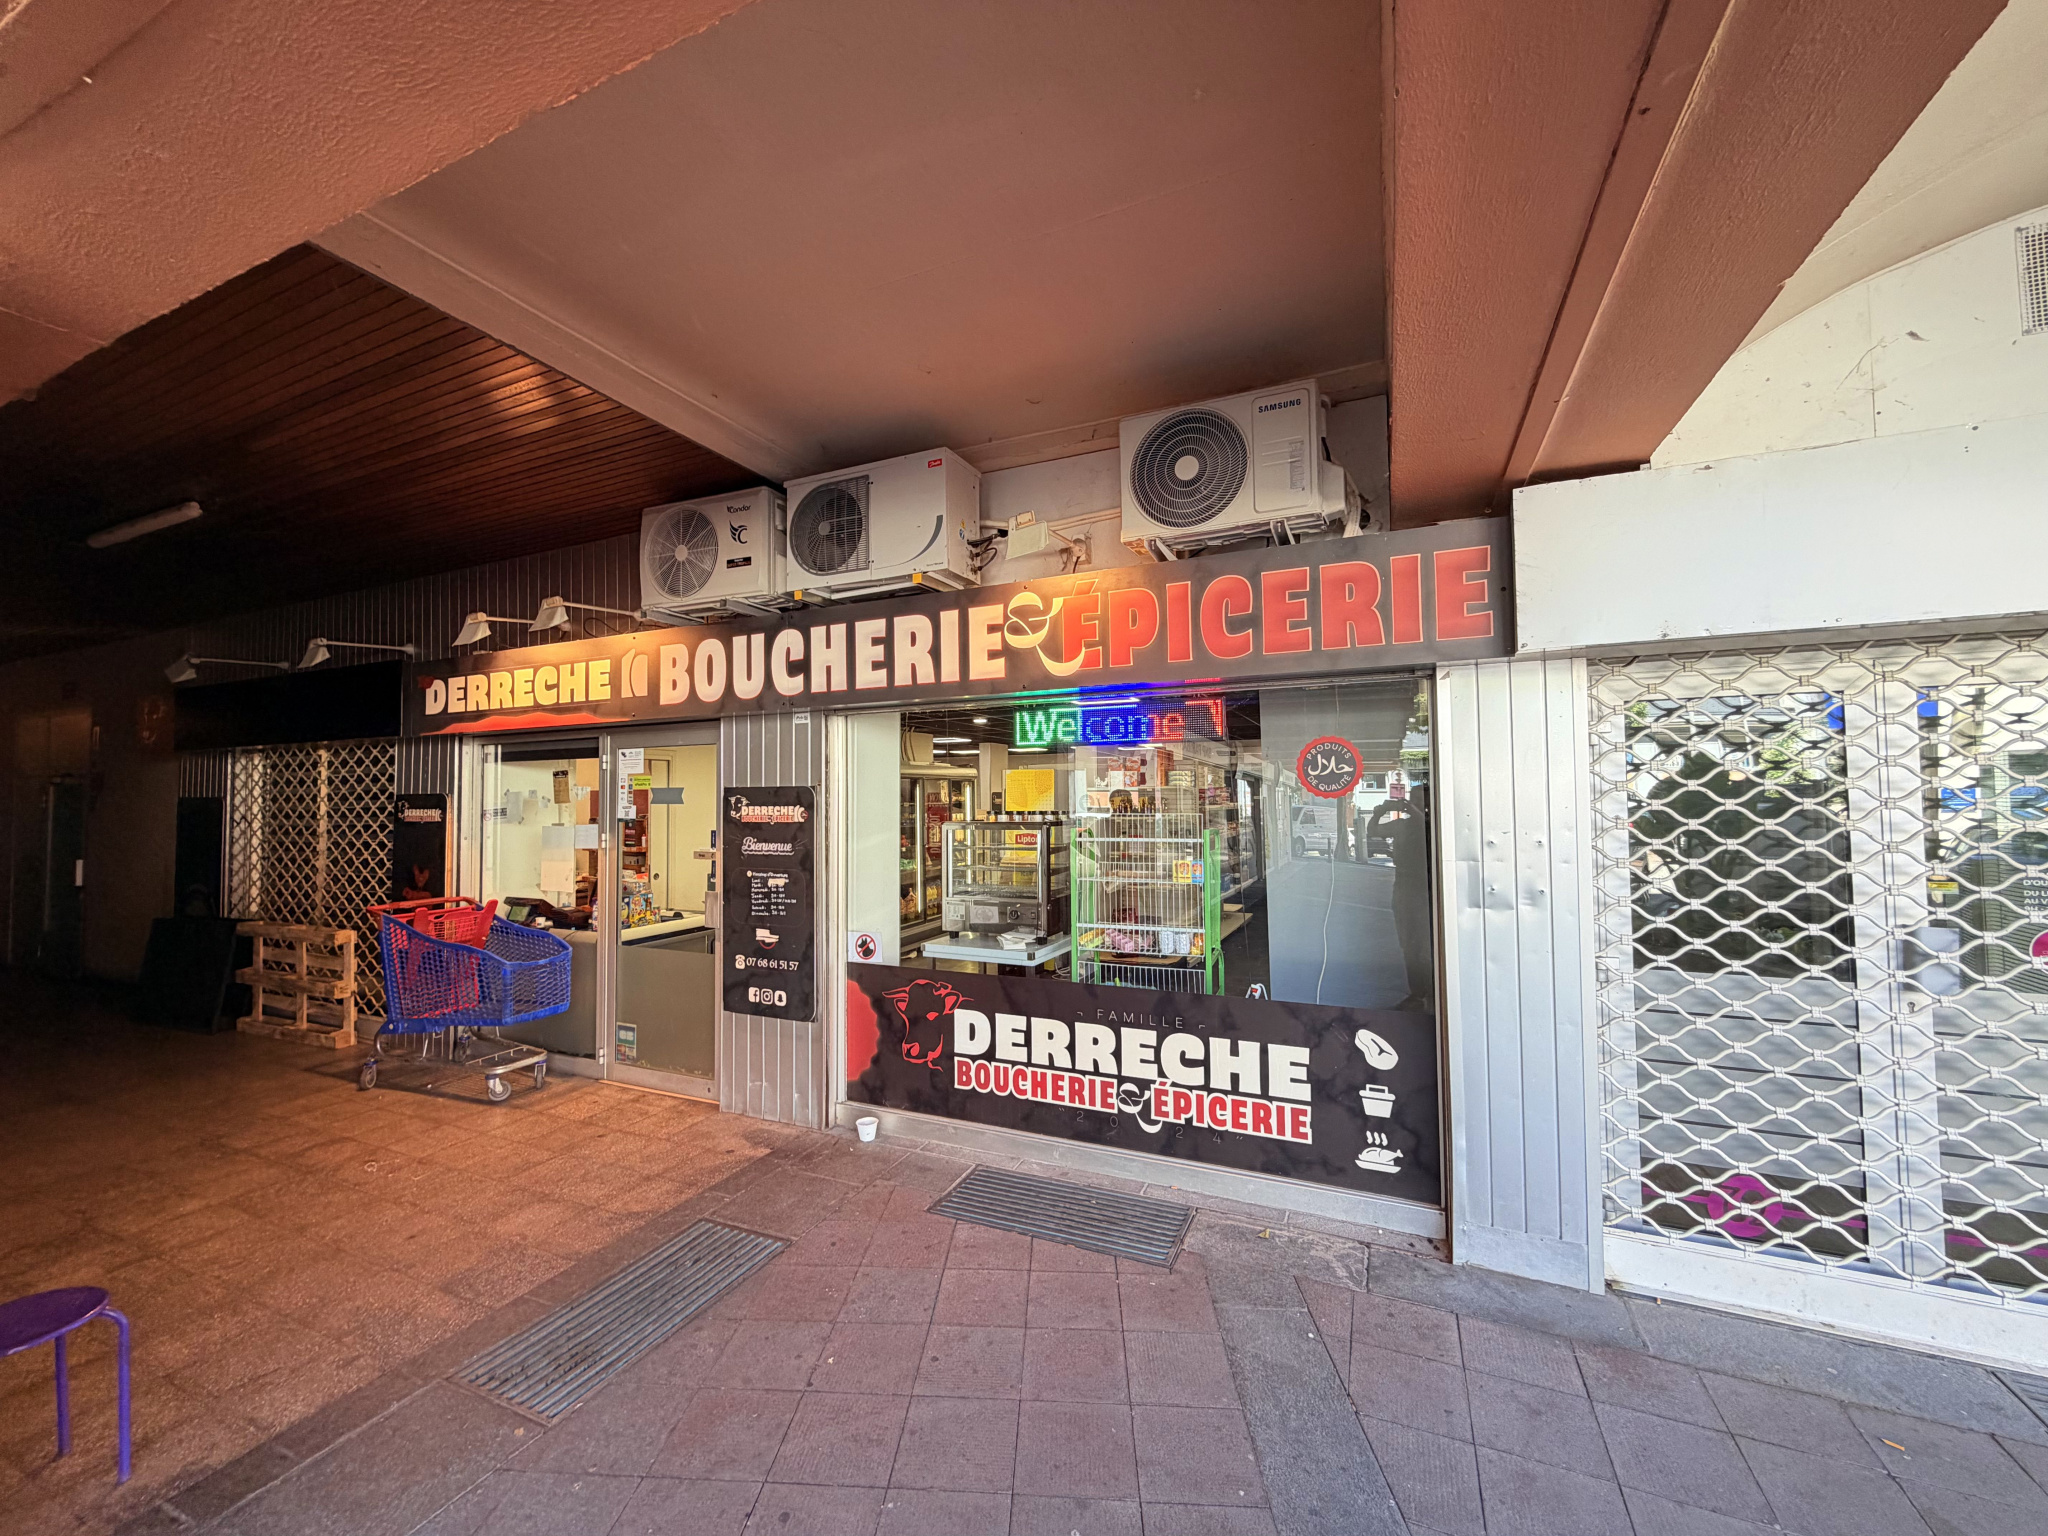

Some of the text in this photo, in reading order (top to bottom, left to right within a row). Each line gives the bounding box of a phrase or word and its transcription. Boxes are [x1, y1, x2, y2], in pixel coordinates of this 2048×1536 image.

[1258, 398, 1302, 414] SAMSUNG
[425, 545, 1495, 716] DERRECHE BOUCHERIE & ÉPICERIE
[1306, 742, 1352, 760] PRODUITS
[1307, 753, 1354, 776] حلال
[1307, 775, 1319, 787] DE
[741, 805, 795, 816] DERRECHE
[741, 836, 793, 852] Bienvenue
[746, 957, 799, 971] 07 68 61 51 57
[1096, 1008, 1185, 1029] FAMILLE
[953, 1008, 1312, 1102] DERRECHE
[954, 1056, 1313, 1145] BOUCHERIE & ÉPICERIE
